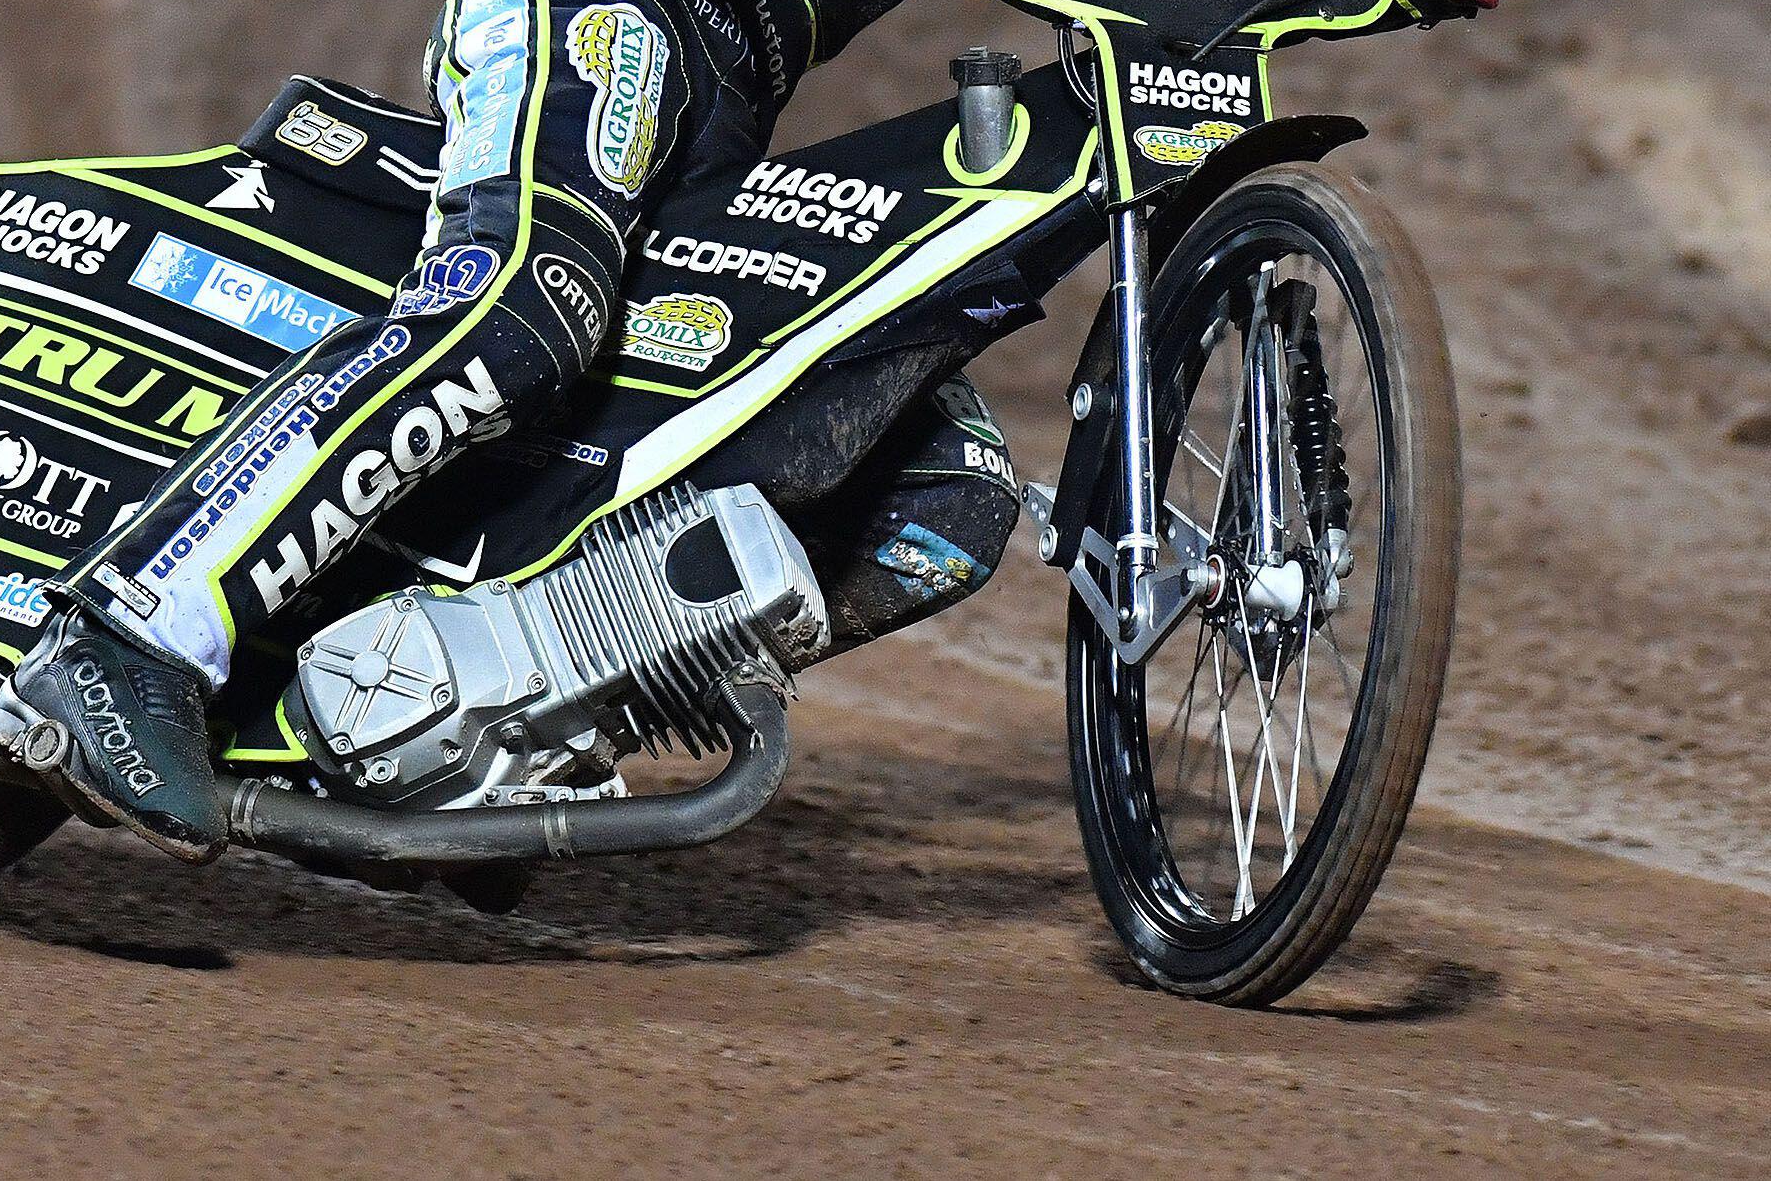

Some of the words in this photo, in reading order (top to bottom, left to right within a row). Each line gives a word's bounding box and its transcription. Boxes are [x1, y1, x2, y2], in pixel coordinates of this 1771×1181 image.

[603, 19, 644, 170] AGROMIX
[1130, 62, 1251, 98] HAGON
[1130, 85, 1251, 117] SHOCKS
[726, 193, 879, 244] SHOCKS
[741, 161, 903, 221] HAGON
[210, 265, 254, 304] Ice
[315, 326, 409, 407] Grant
[196, 374, 321, 493] Tankers
[153, 409, 315, 579] Henderson
[249, 356, 505, 615] HAGON
[1, 499, 82, 539] GROUP
